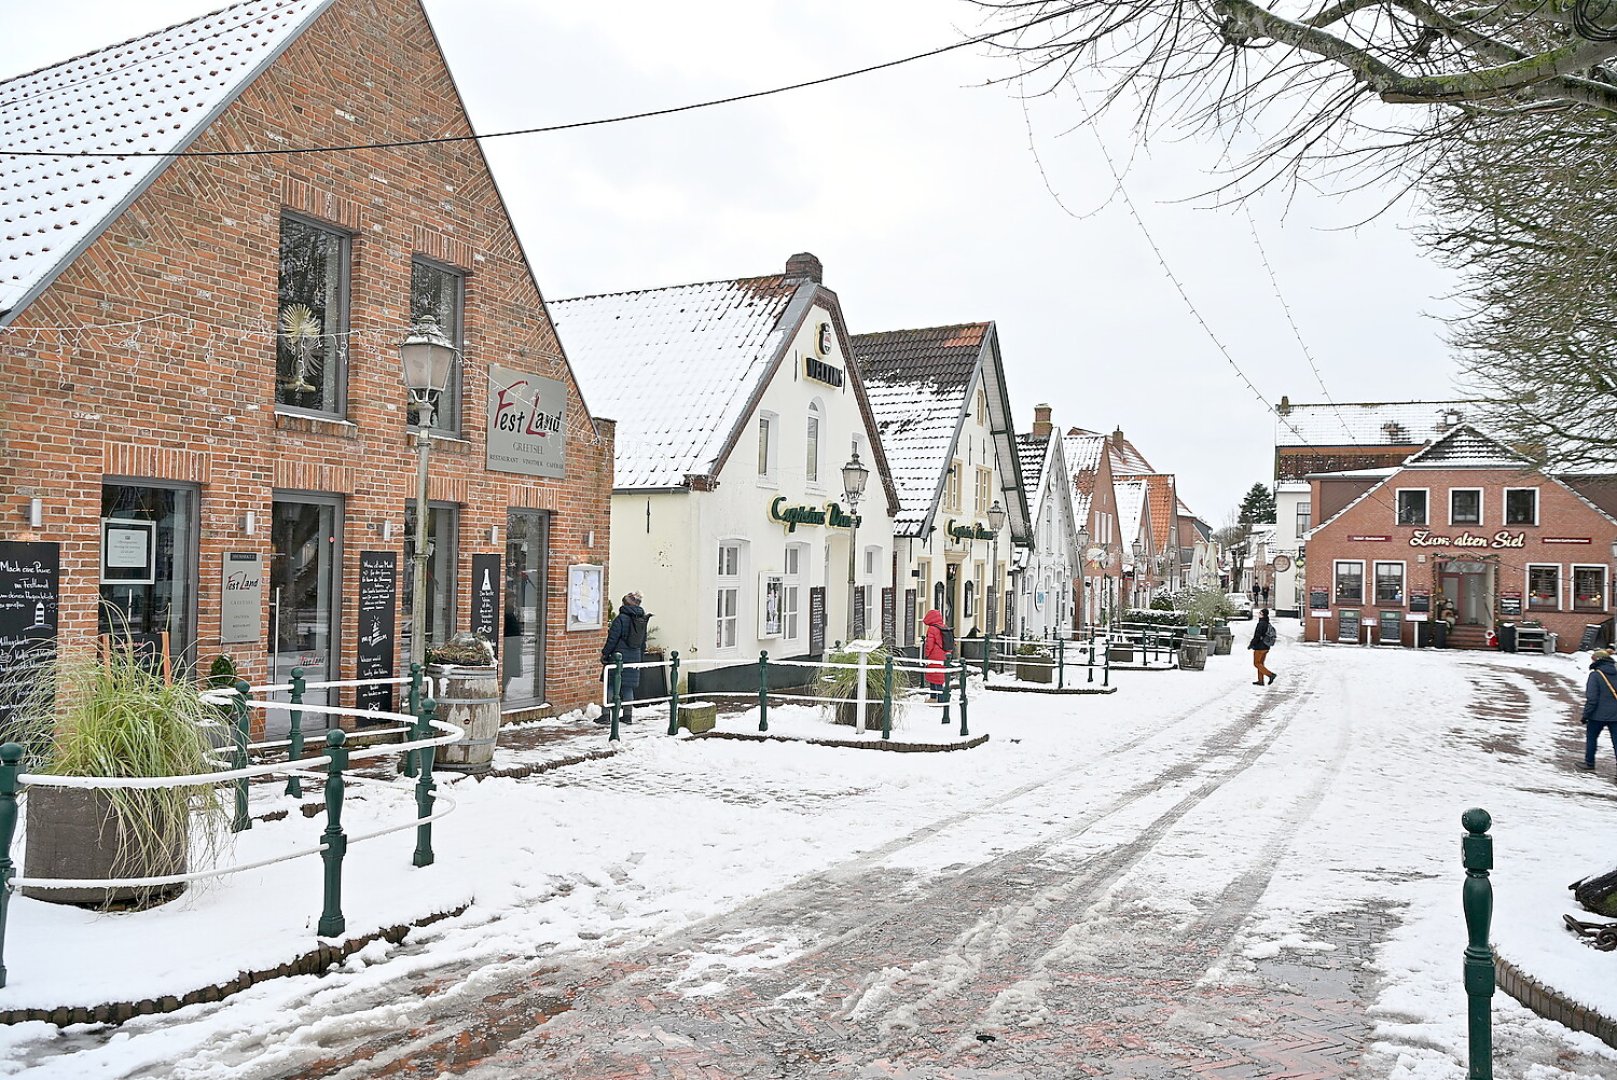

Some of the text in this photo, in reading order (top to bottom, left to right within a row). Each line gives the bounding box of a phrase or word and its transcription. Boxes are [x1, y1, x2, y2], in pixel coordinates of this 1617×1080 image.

[806, 357, 843, 387] VELTINS
[1409, 529, 1526, 549] Zum alten Siel
